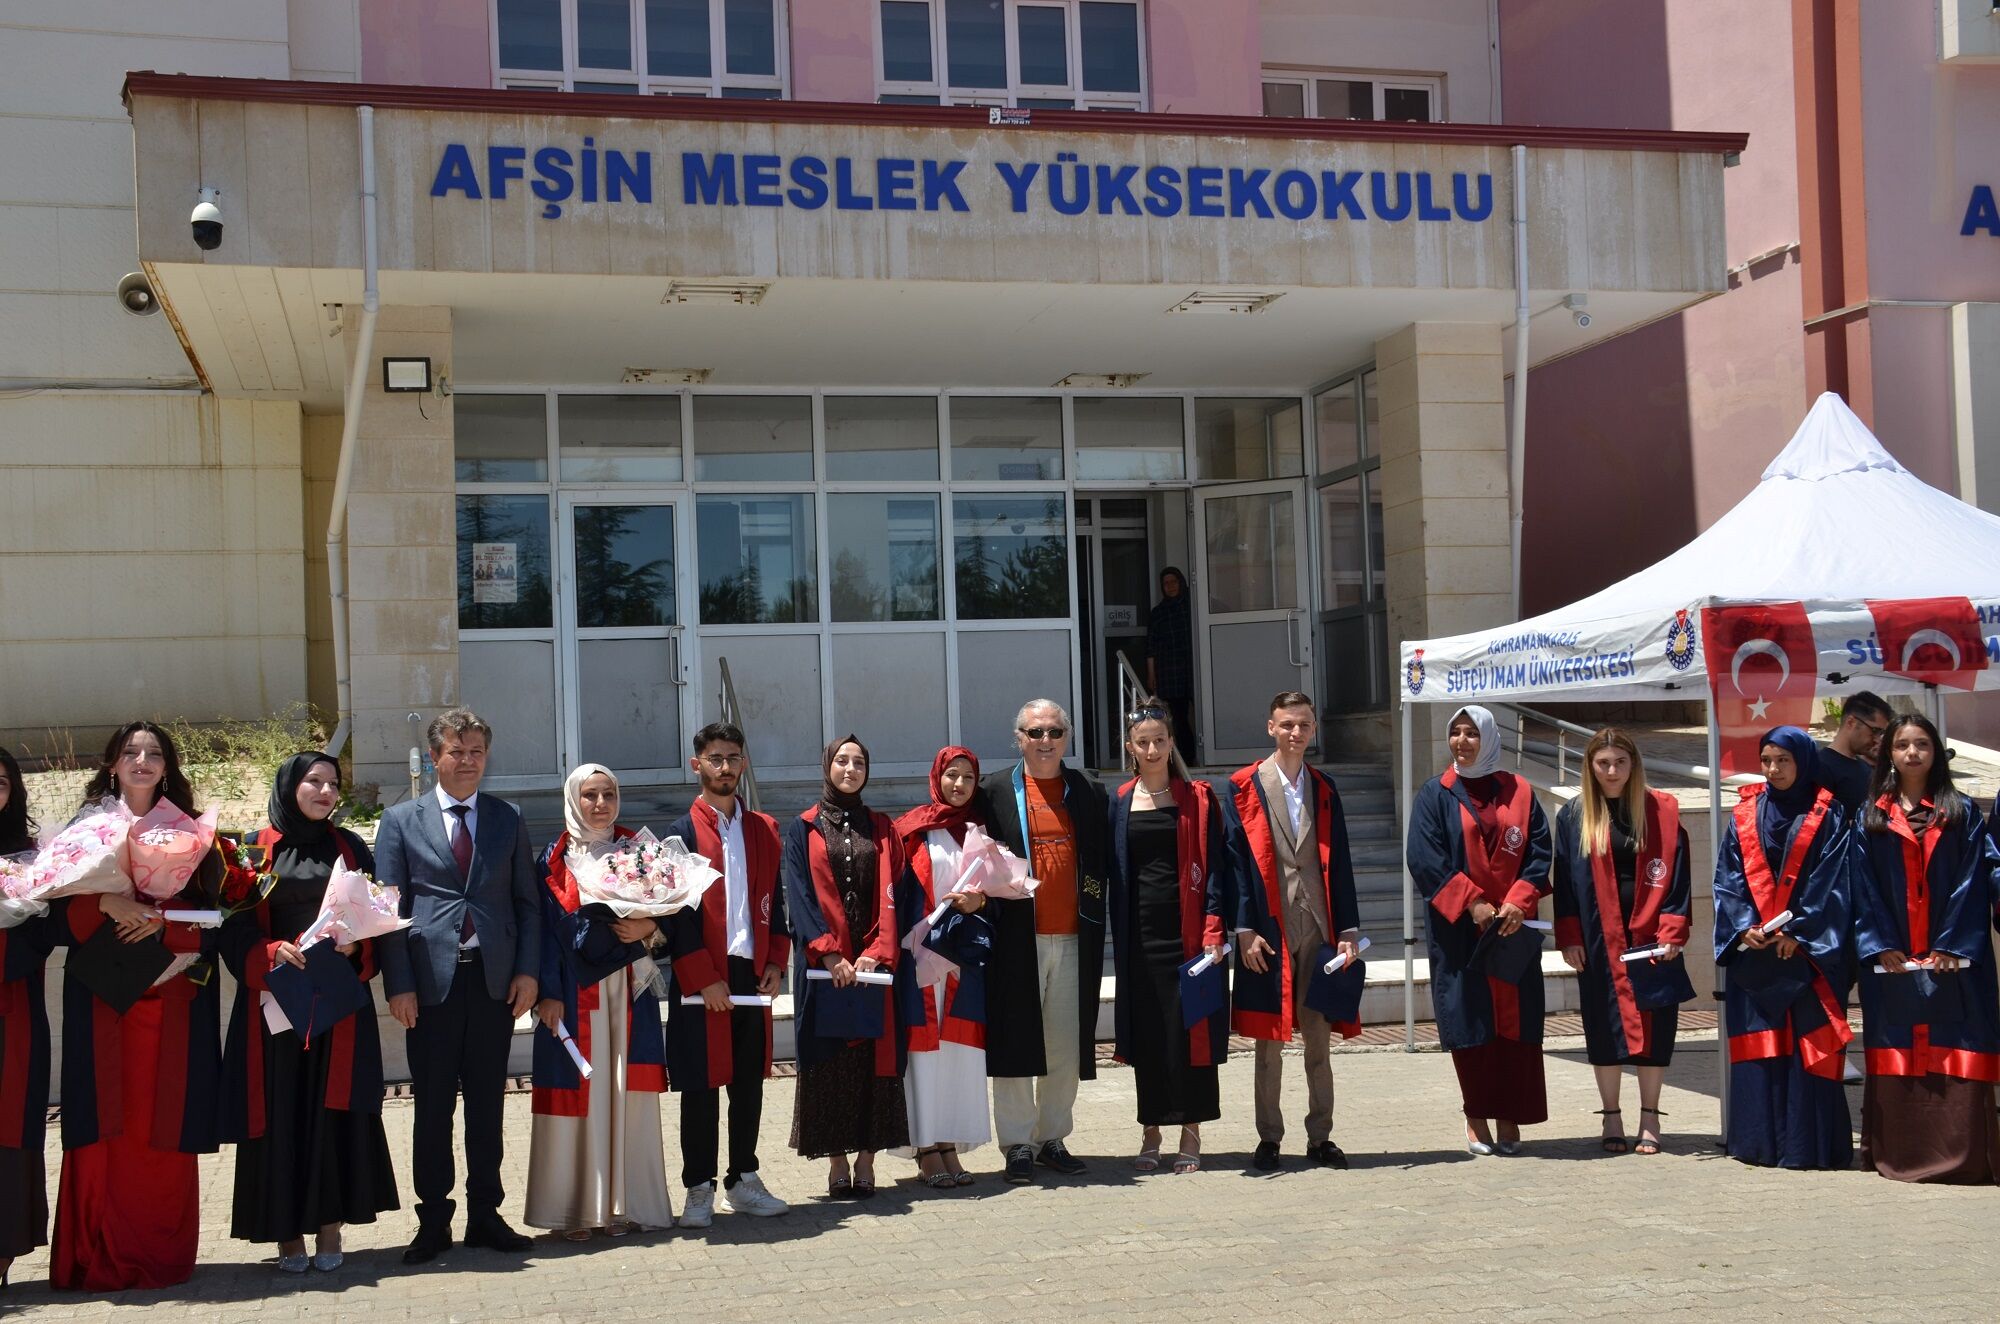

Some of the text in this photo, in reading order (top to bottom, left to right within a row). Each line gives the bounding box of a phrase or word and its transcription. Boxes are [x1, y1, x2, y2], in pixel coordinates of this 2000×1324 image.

[430, 138, 1493, 222] AFŞİN MESLEK YÜKSEKOKULU
[1447, 661, 1487, 697] SÜTÇÜ
[1490, 660, 1525, 690] İMAM
[1529, 643, 1635, 686] ÜNİVERSİTESİ
[1487, 631, 1582, 655] KAHRAMANMARAŞ
